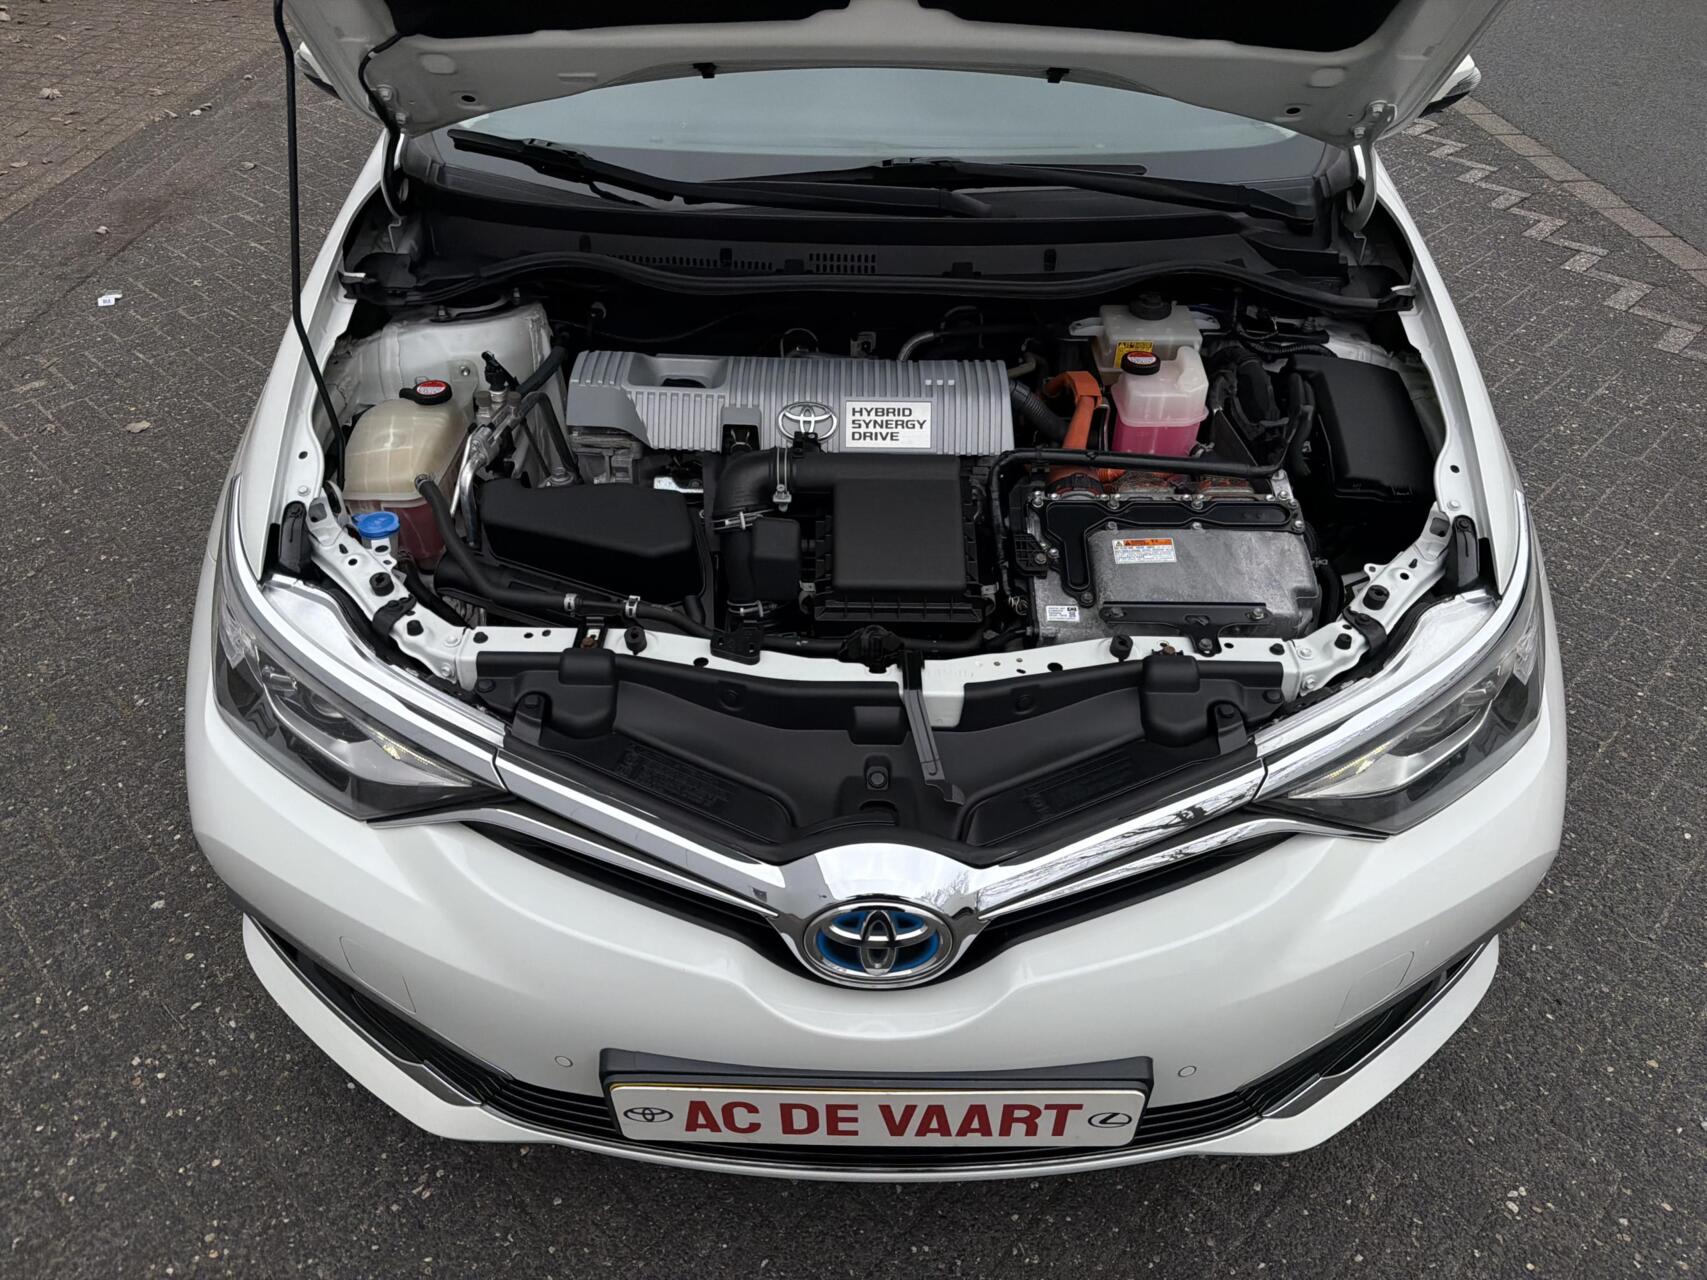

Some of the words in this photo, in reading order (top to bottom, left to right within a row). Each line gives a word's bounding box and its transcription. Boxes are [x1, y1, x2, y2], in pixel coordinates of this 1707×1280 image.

[851, 407, 913, 417] HYBRID
[851, 419, 927, 429] SYNERGY
[851, 431, 900, 441] DRIVE
[685, 1100, 762, 1134] AC
[779, 1103, 860, 1136] DE
[878, 1103, 1084, 1137] VAART
